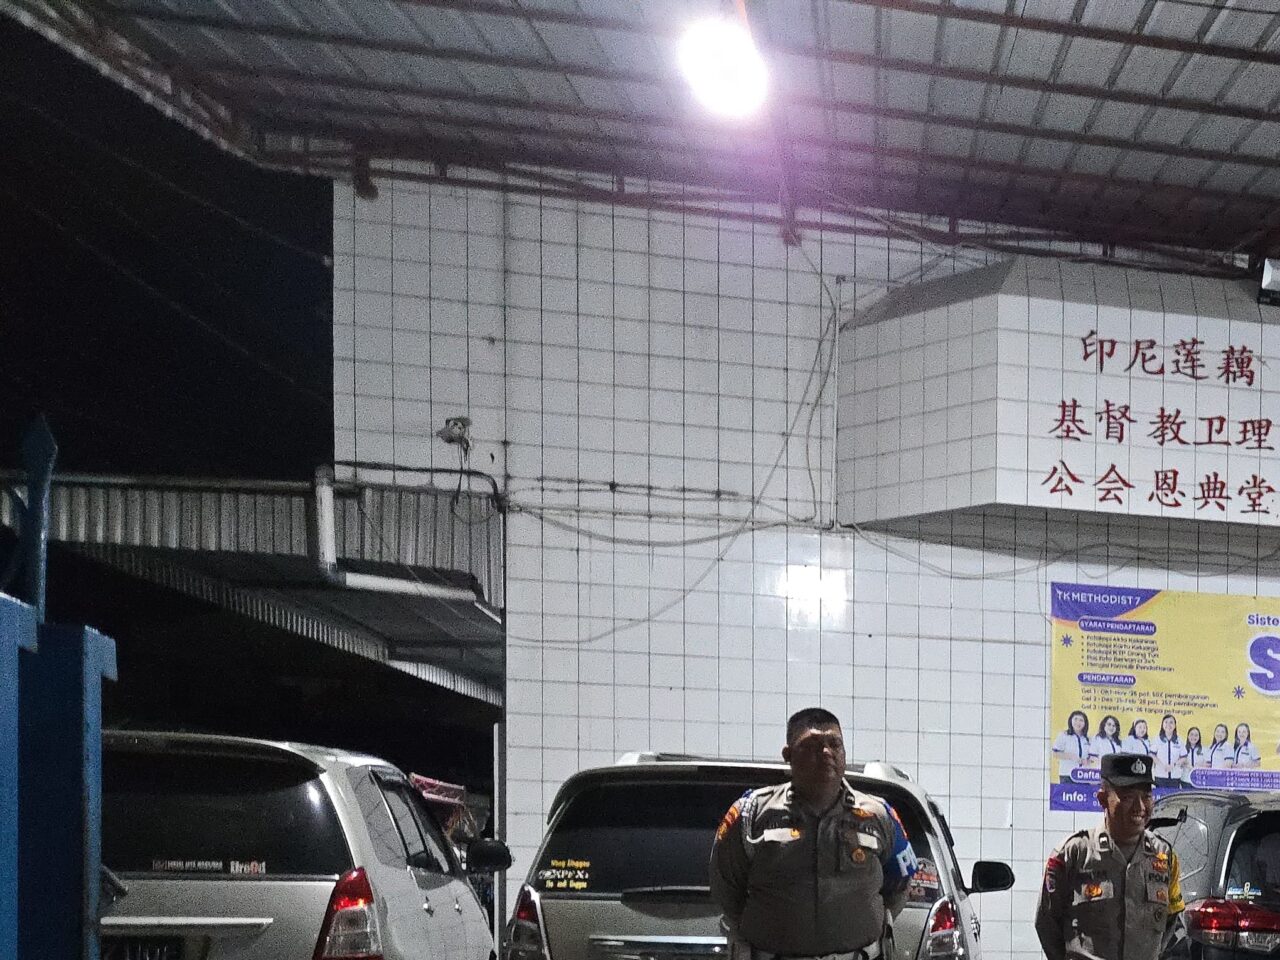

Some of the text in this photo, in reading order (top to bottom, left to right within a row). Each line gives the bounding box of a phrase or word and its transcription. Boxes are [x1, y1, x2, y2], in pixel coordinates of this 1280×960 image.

[1048, 397, 1276, 451] 基督教卫理
[1041, 459, 1276, 514] 公会恩典堂
[1071, 592, 1133, 605] METHODIST
[1135, 596, 1141, 606] 7
[1082, 674, 1134, 684] PENDAFTARAN
[1077, 770, 1100, 780] Dafta
[1062, 791, 1087, 802] Info:
